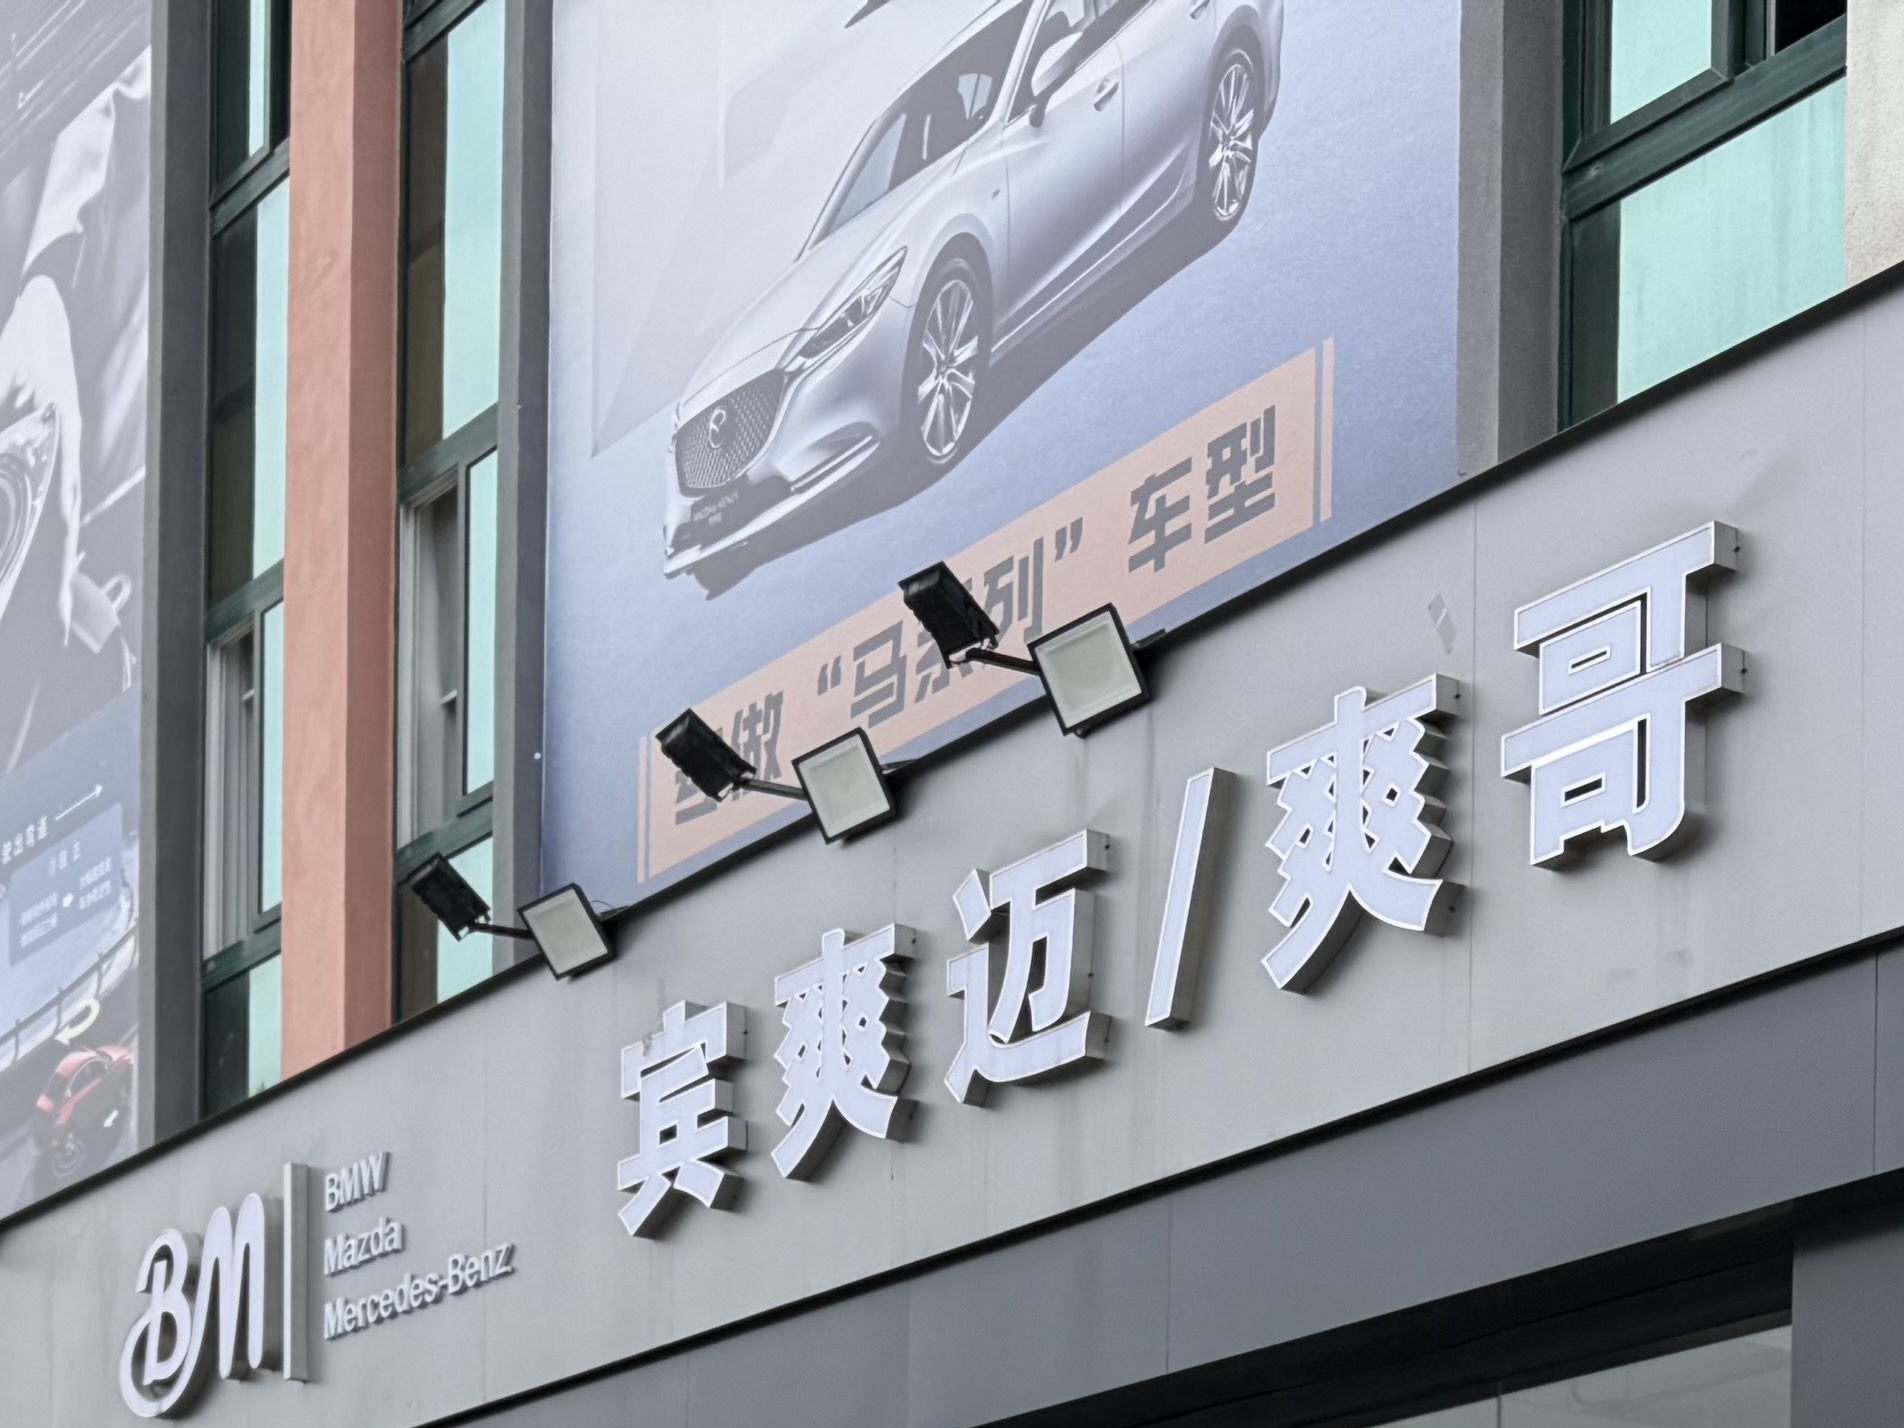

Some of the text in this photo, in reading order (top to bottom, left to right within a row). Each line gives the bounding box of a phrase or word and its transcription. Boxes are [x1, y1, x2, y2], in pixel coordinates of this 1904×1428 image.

[1127, 405, 1276, 573] 车型
[616, 519, 1741, 1238] 宾爽迈/爽哥
[324, 1150, 390, 1212] BMW
[324, 1216, 403, 1277] Mazda
[324, 1241, 515, 1341] Mercedes-Benz
